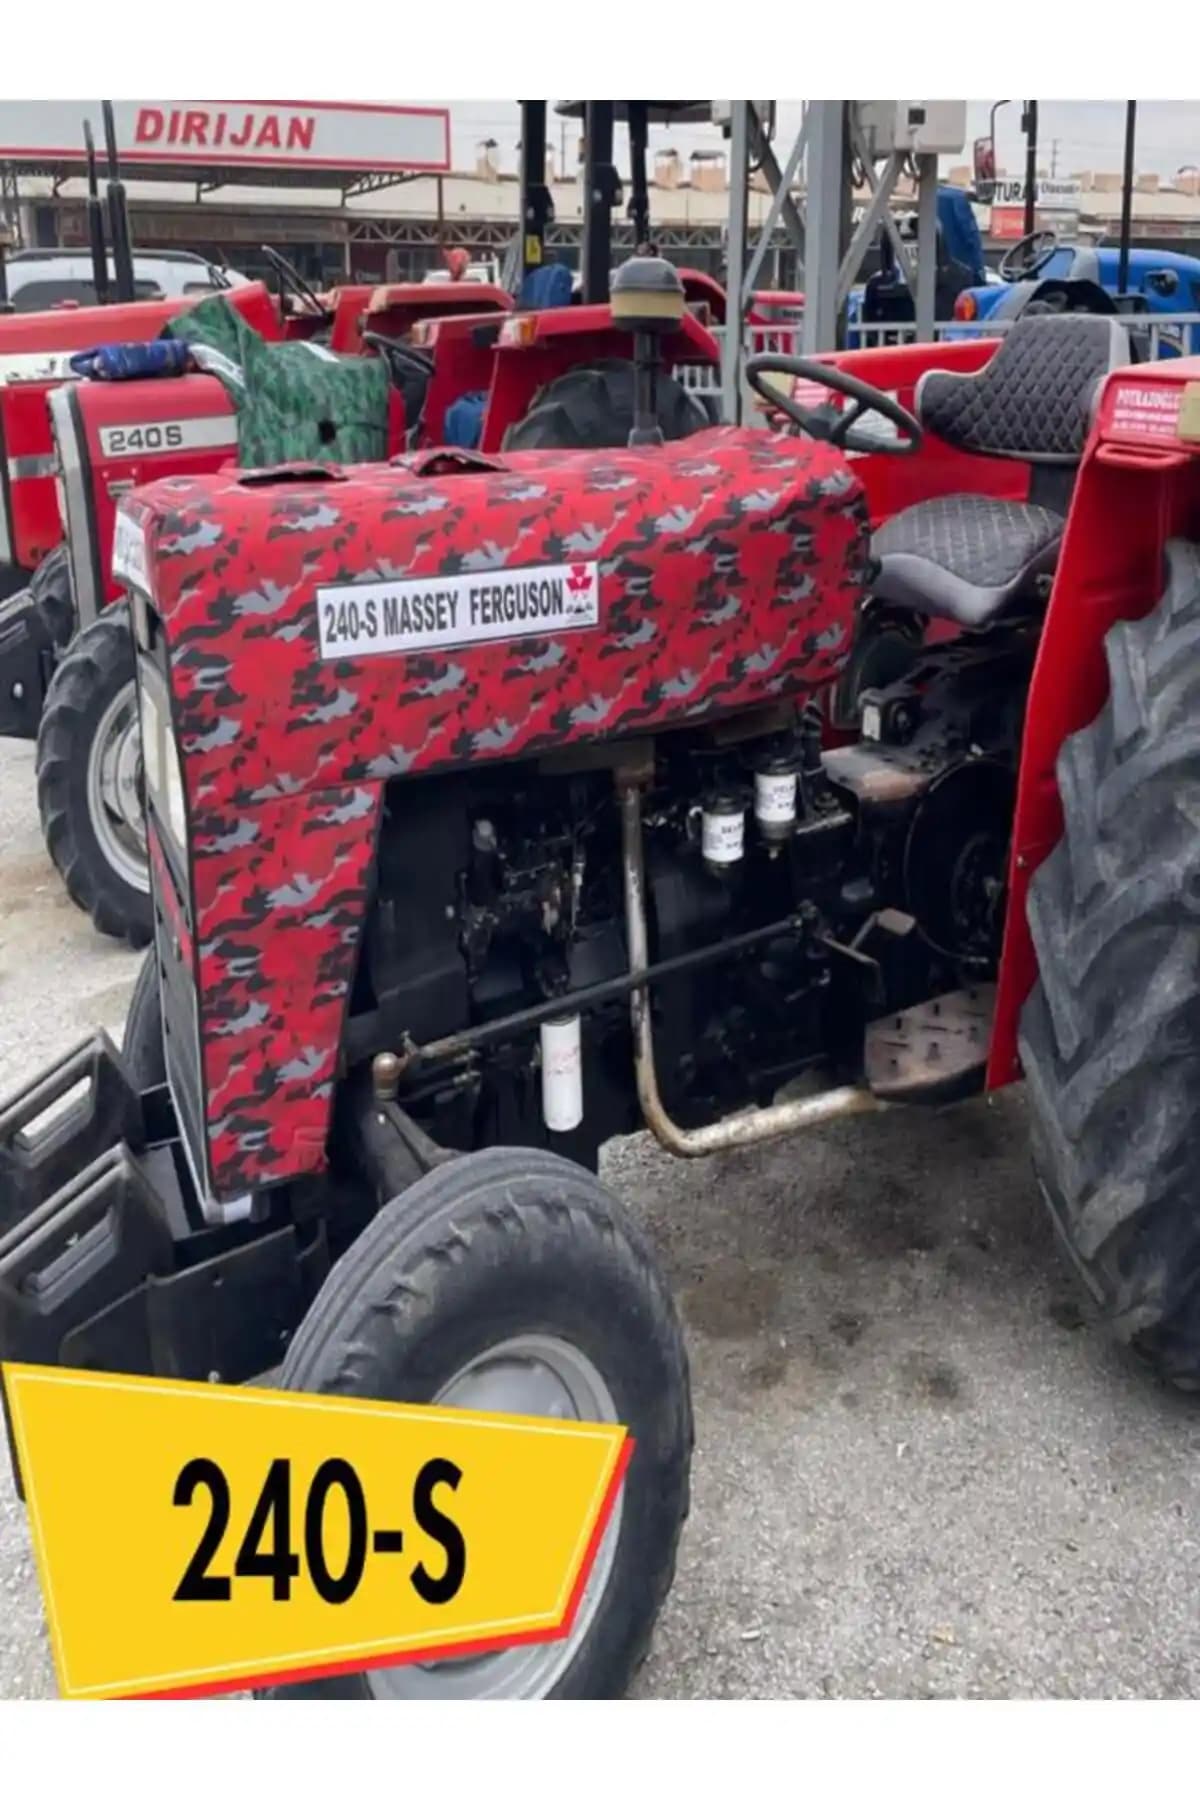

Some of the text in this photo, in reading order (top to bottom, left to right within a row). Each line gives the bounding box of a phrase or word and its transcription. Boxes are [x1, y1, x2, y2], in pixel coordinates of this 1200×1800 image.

[135, 108, 315, 150] DIRIJAN
[325, 578, 563, 643] 240-S MASSEY FERGUSON
